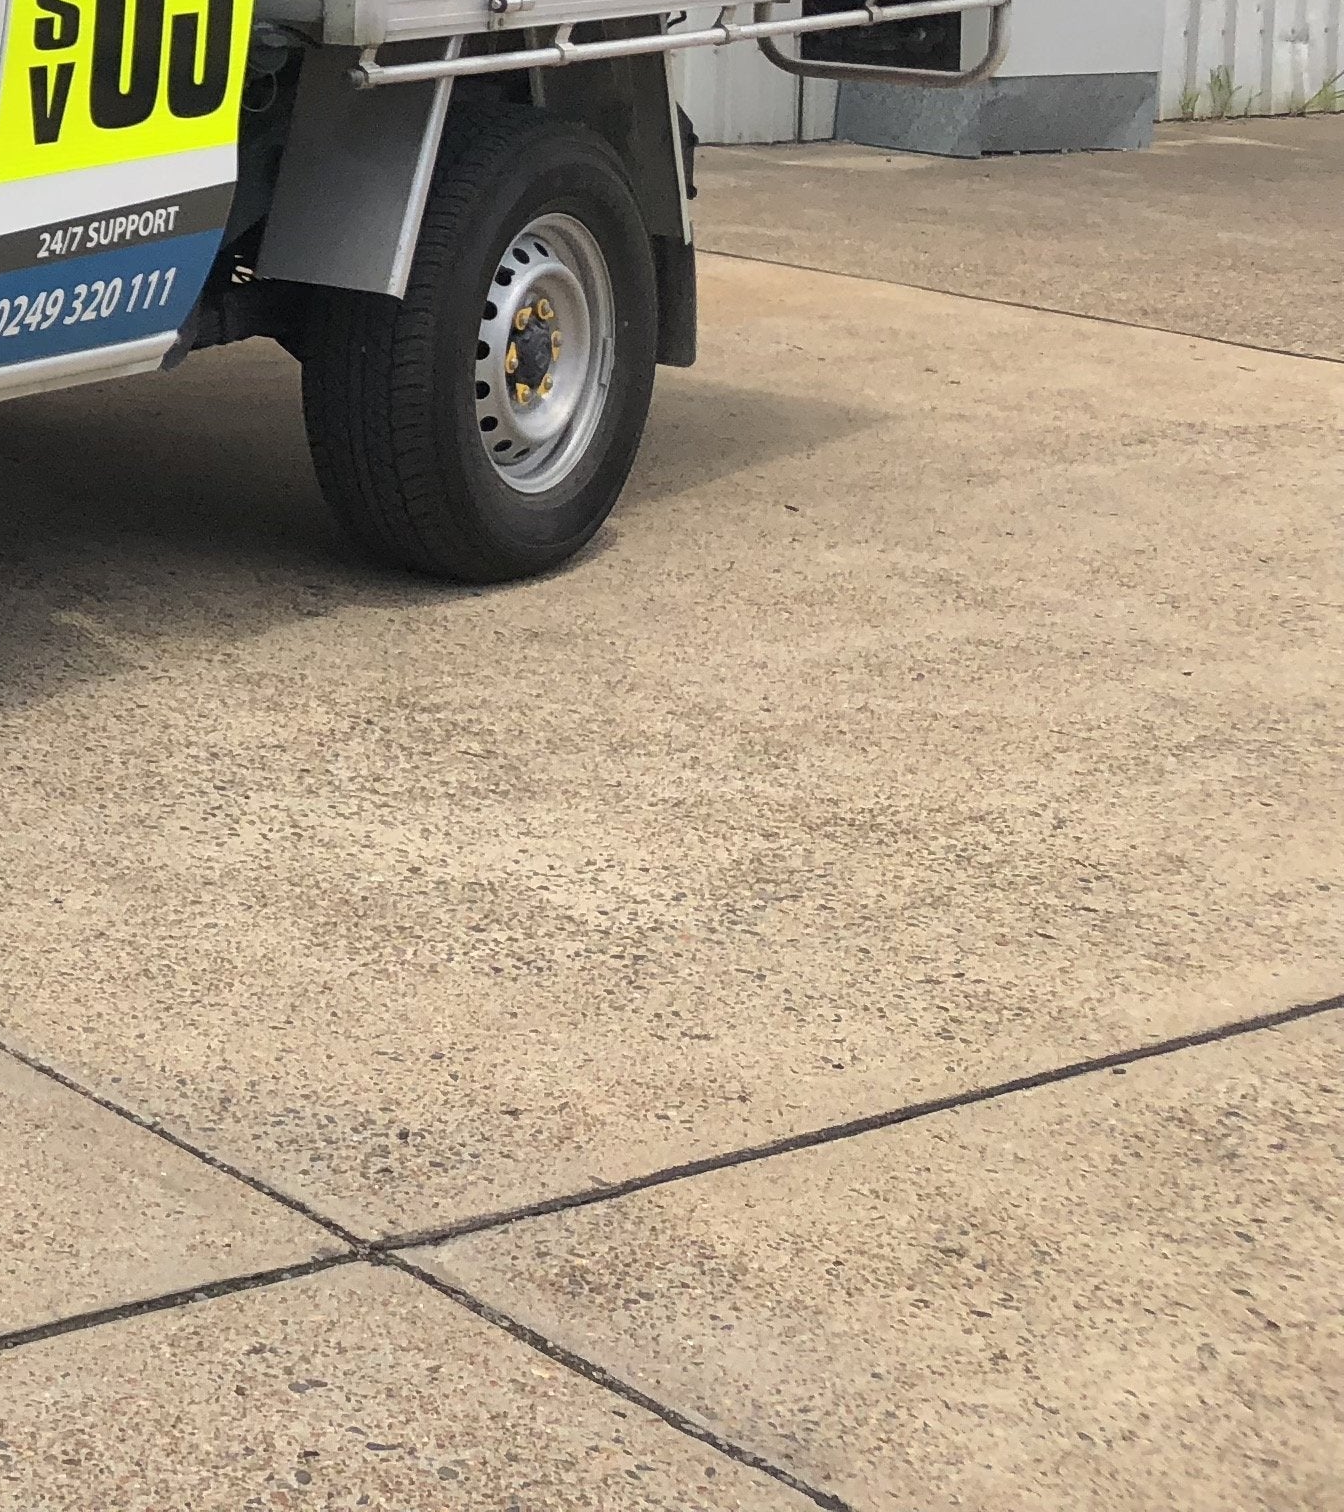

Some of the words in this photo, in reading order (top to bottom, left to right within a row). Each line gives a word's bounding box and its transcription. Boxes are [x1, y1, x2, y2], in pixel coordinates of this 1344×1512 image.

[37, 223, 85, 260] 24/7
[87, 205, 180, 249] SUPPORT
[64, 280, 123, 327] 320
[126, 267, 178, 313] 111
